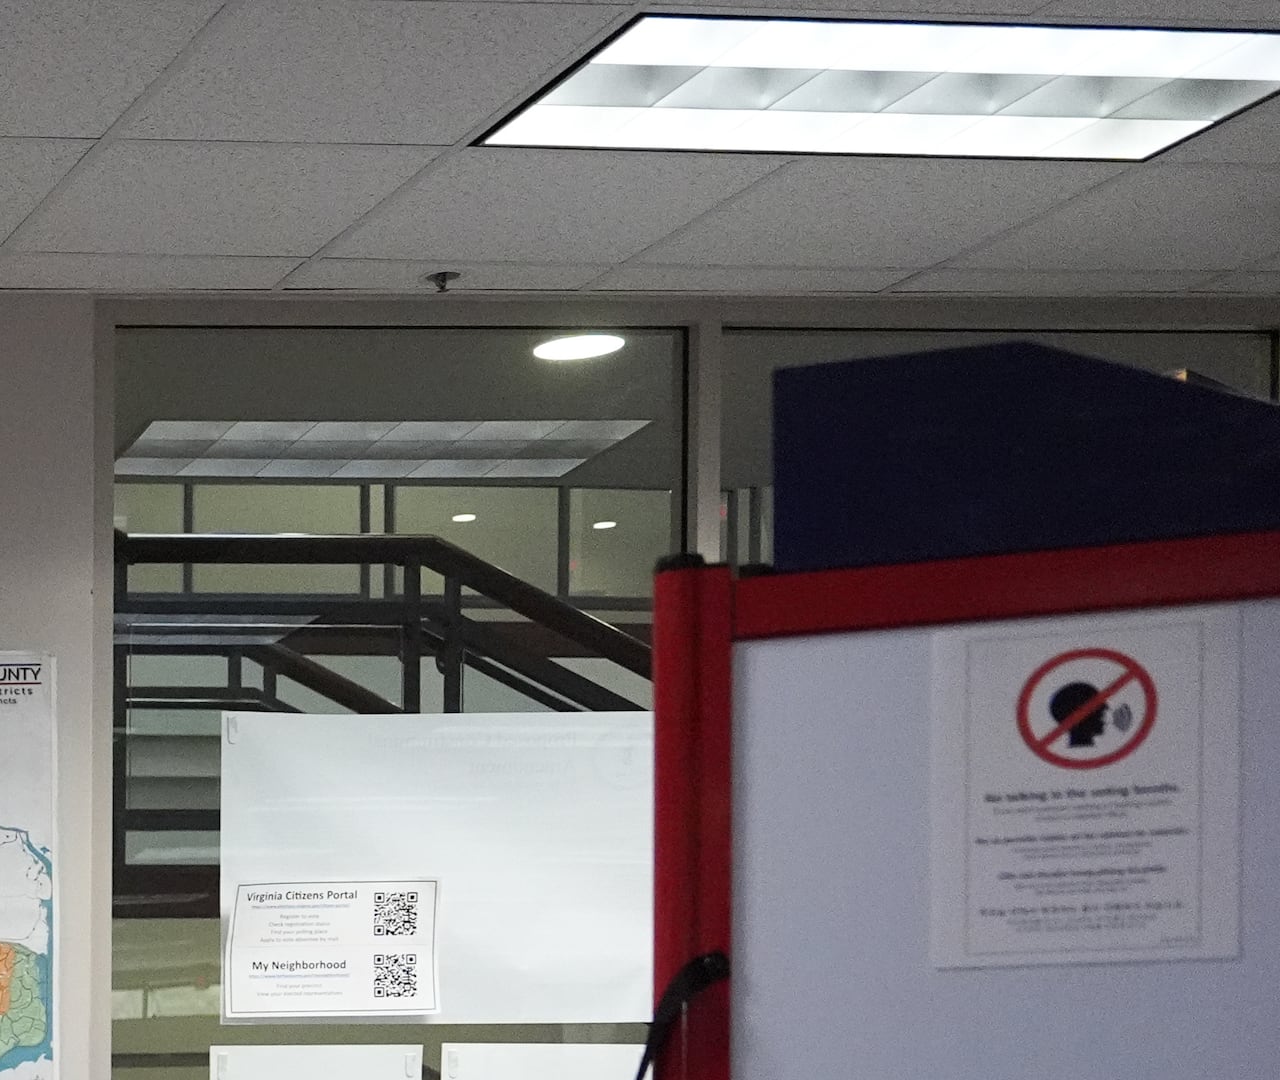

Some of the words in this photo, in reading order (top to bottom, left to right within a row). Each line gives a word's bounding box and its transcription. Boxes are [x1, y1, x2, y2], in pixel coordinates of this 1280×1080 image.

[248, 892, 282, 903] Virginia
[286, 891, 324, 900] Citizens
[327, 890, 358, 900] Portal
[252, 961, 268, 972] My
[272, 960, 347, 972] Neighborhood
